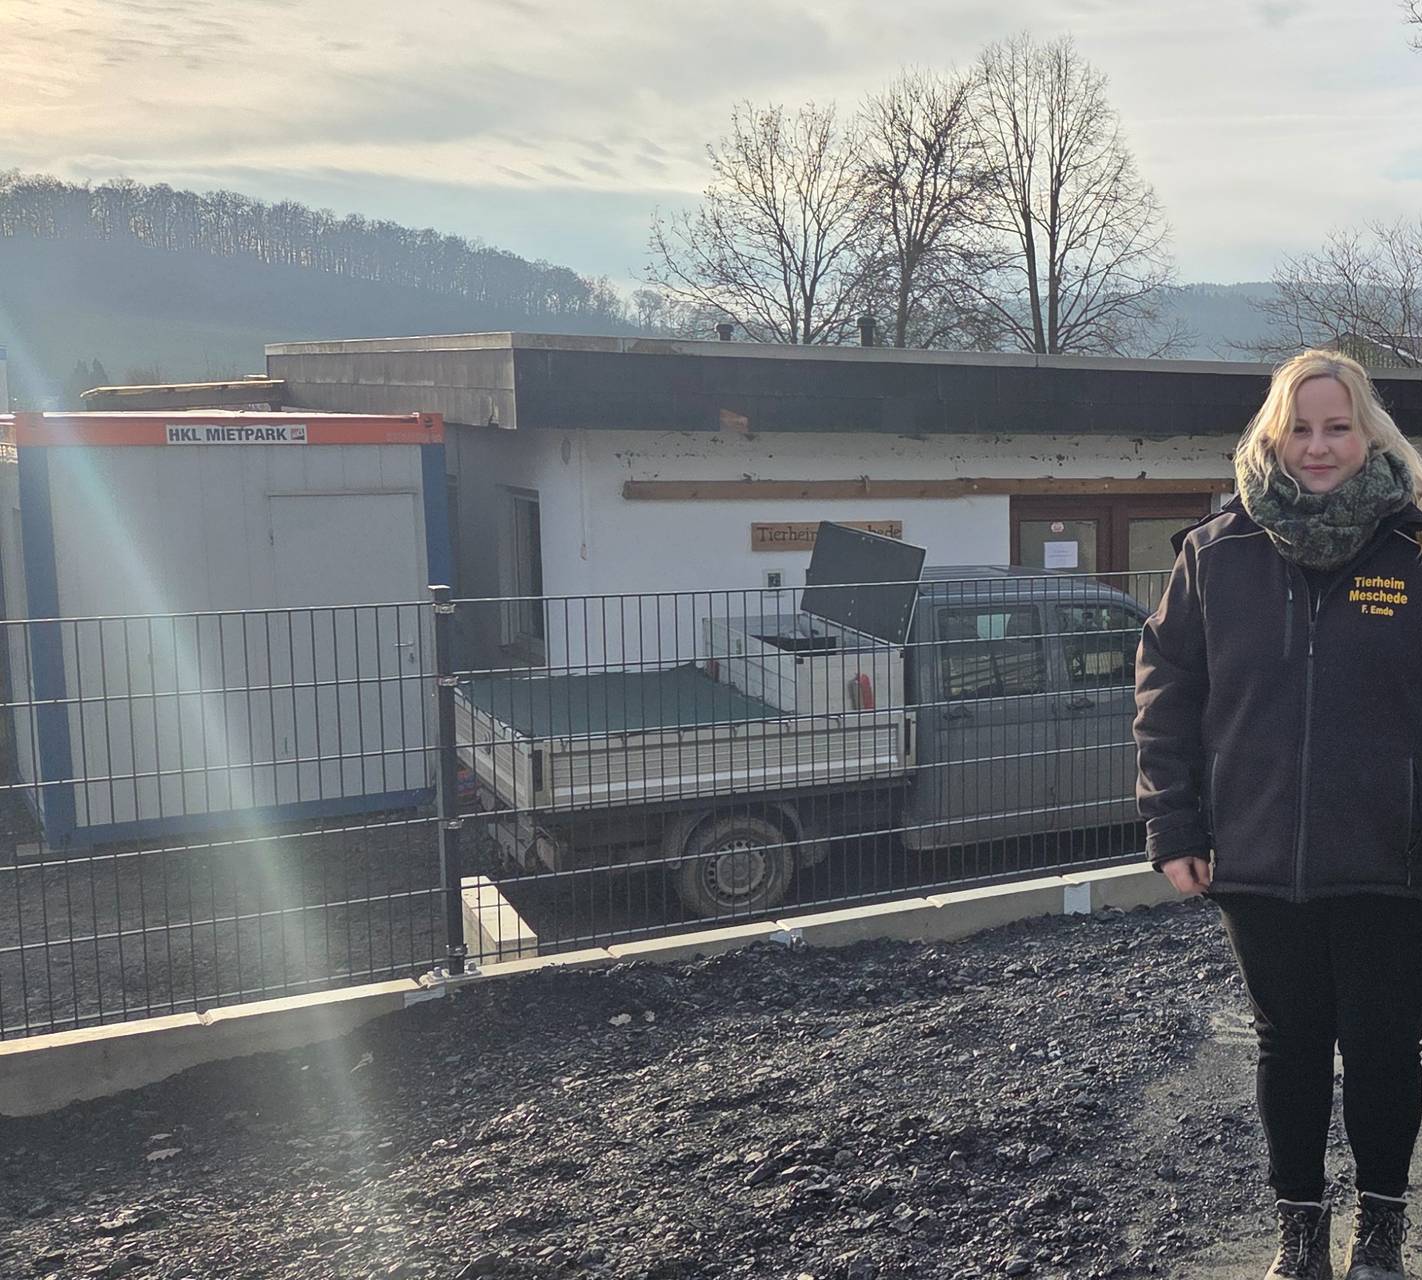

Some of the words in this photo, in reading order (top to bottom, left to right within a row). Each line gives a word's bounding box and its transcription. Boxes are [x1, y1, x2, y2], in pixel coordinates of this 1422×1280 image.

[168, 428, 201, 442] HKL
[206, 427, 287, 442] MIETPARK
[1354, 575, 1405, 590] Tierheim
[1349, 590, 1408, 604] Meschede
[1361, 604, 1369, 614] F.
[1370, 605, 1394, 617] Emde
